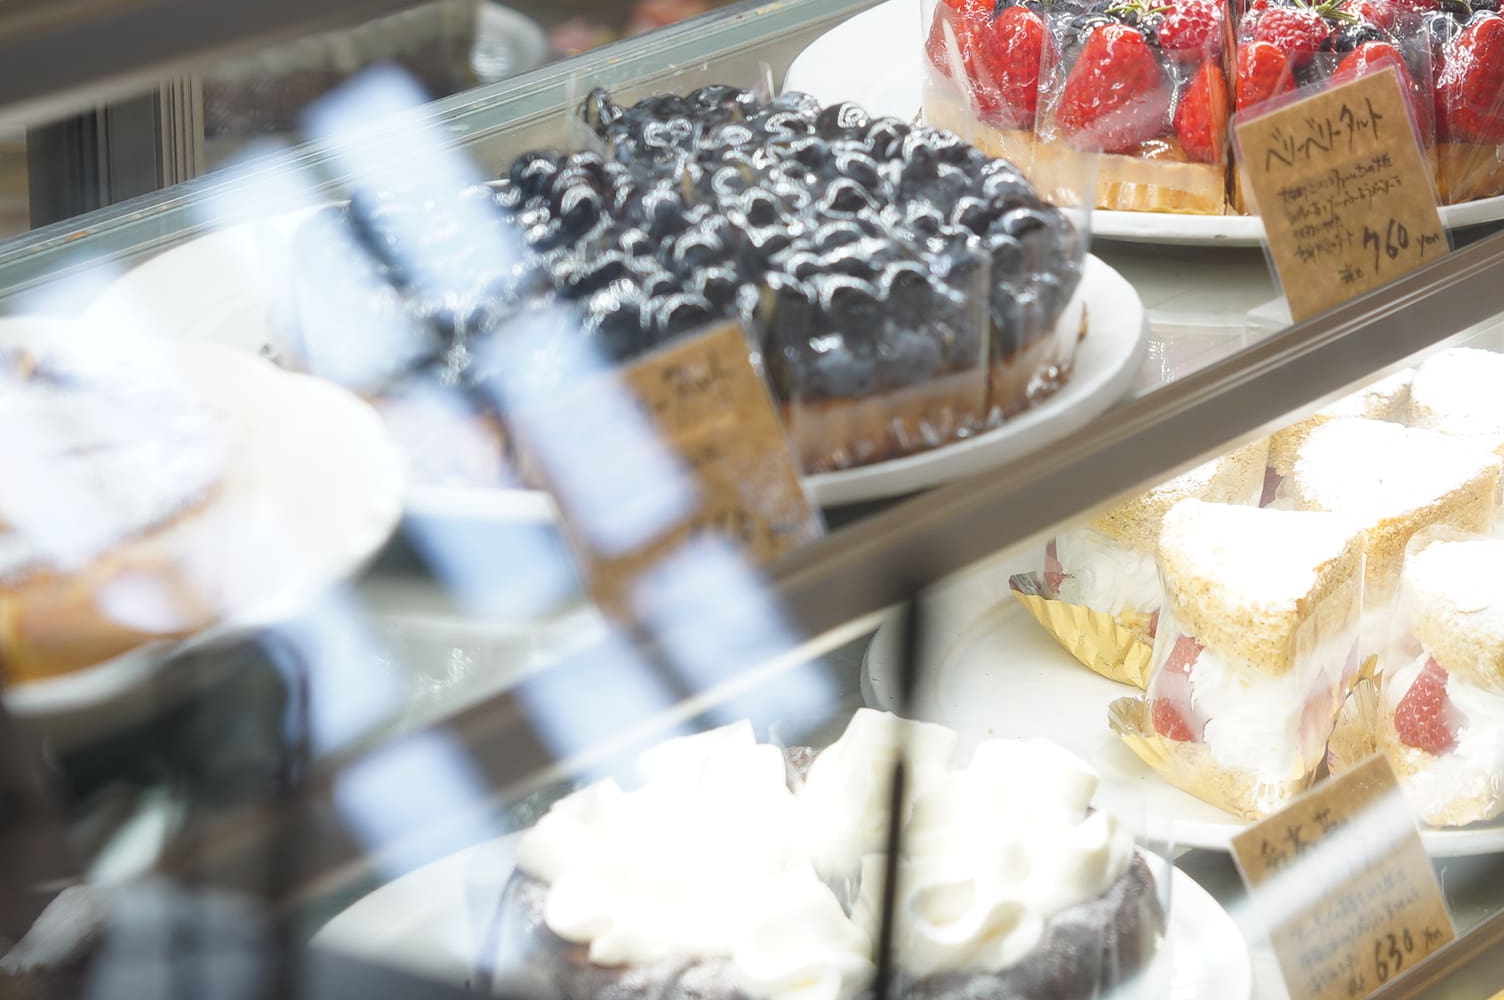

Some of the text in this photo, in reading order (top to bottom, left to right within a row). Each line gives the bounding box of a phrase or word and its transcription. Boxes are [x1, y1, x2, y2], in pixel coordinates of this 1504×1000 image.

[1362, 217, 1409, 275] 760
[1415, 232, 1441, 257] yen
[1373, 927, 1415, 984] 630
